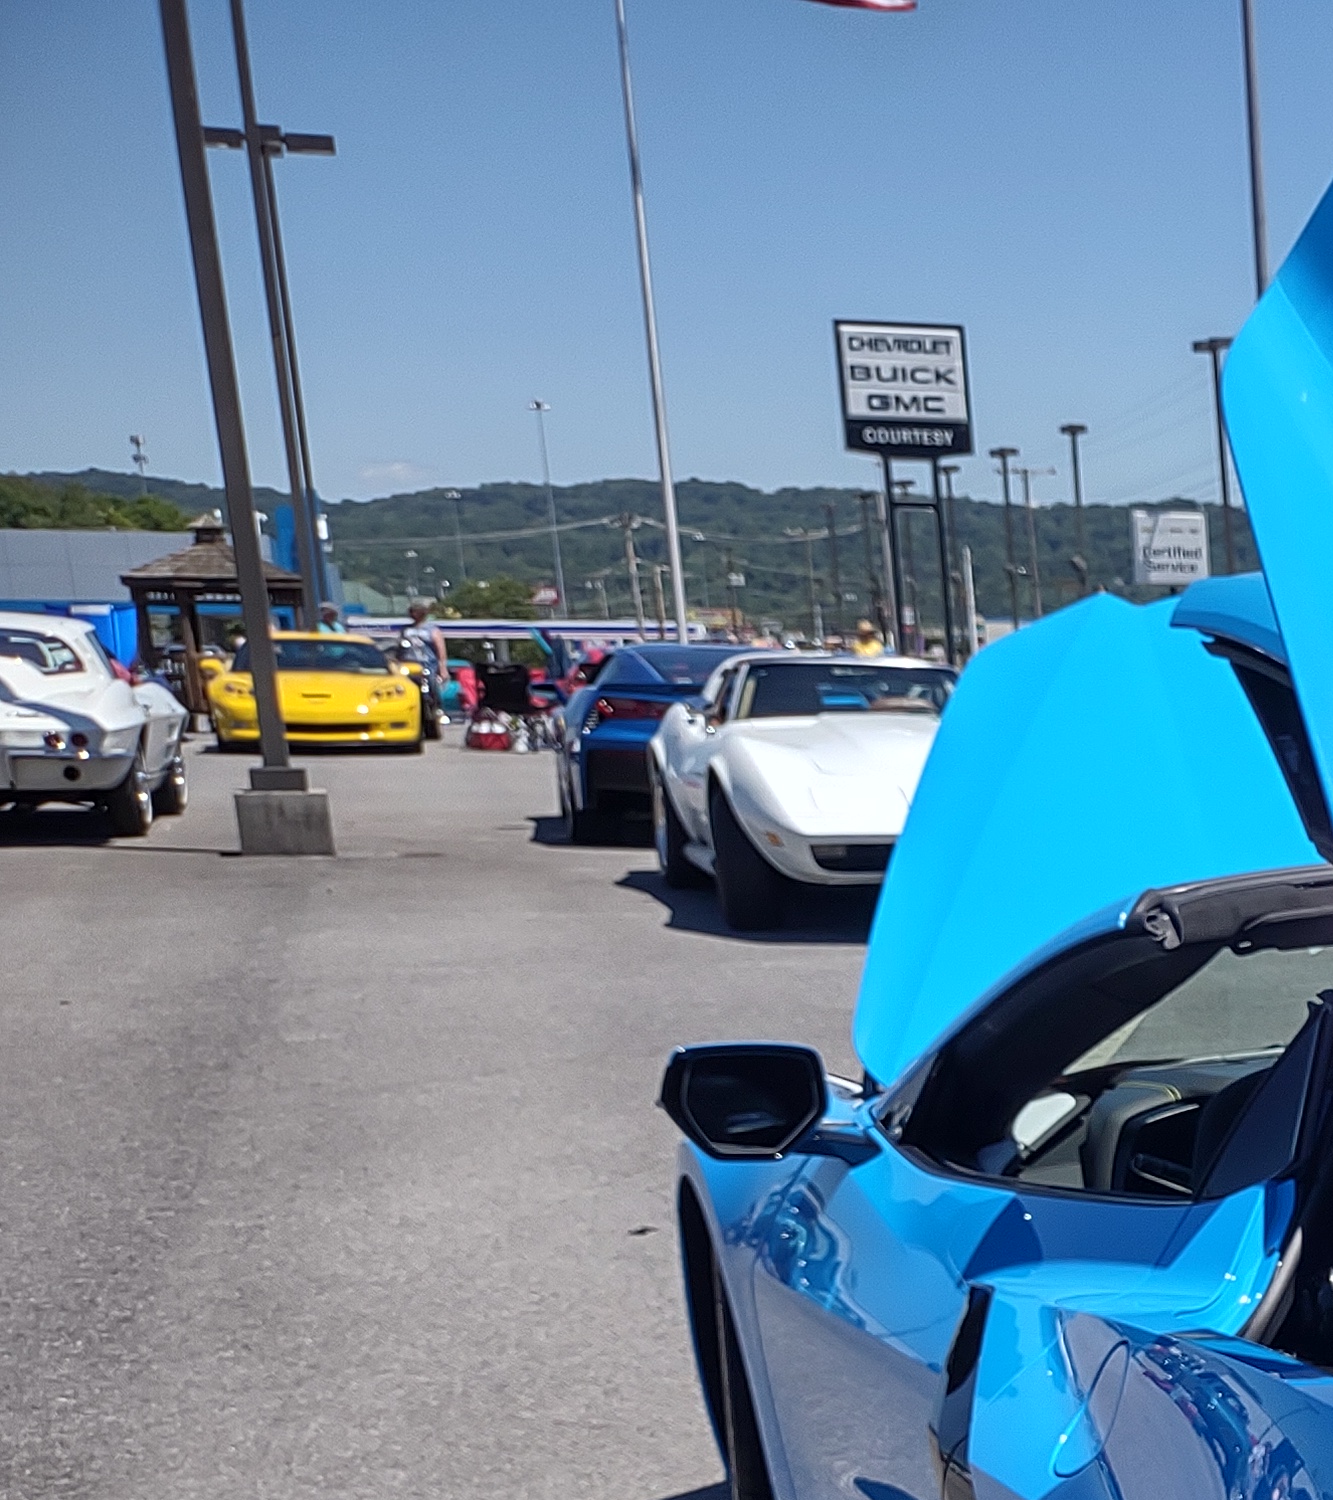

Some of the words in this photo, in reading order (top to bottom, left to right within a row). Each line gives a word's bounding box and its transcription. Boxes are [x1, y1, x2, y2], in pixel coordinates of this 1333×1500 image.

[848, 335, 953, 355] CHEVROLET
[850, 364, 956, 385] BUICK
[867, 394, 946, 413] GMC
[862, 425, 954, 447] COURTESY
